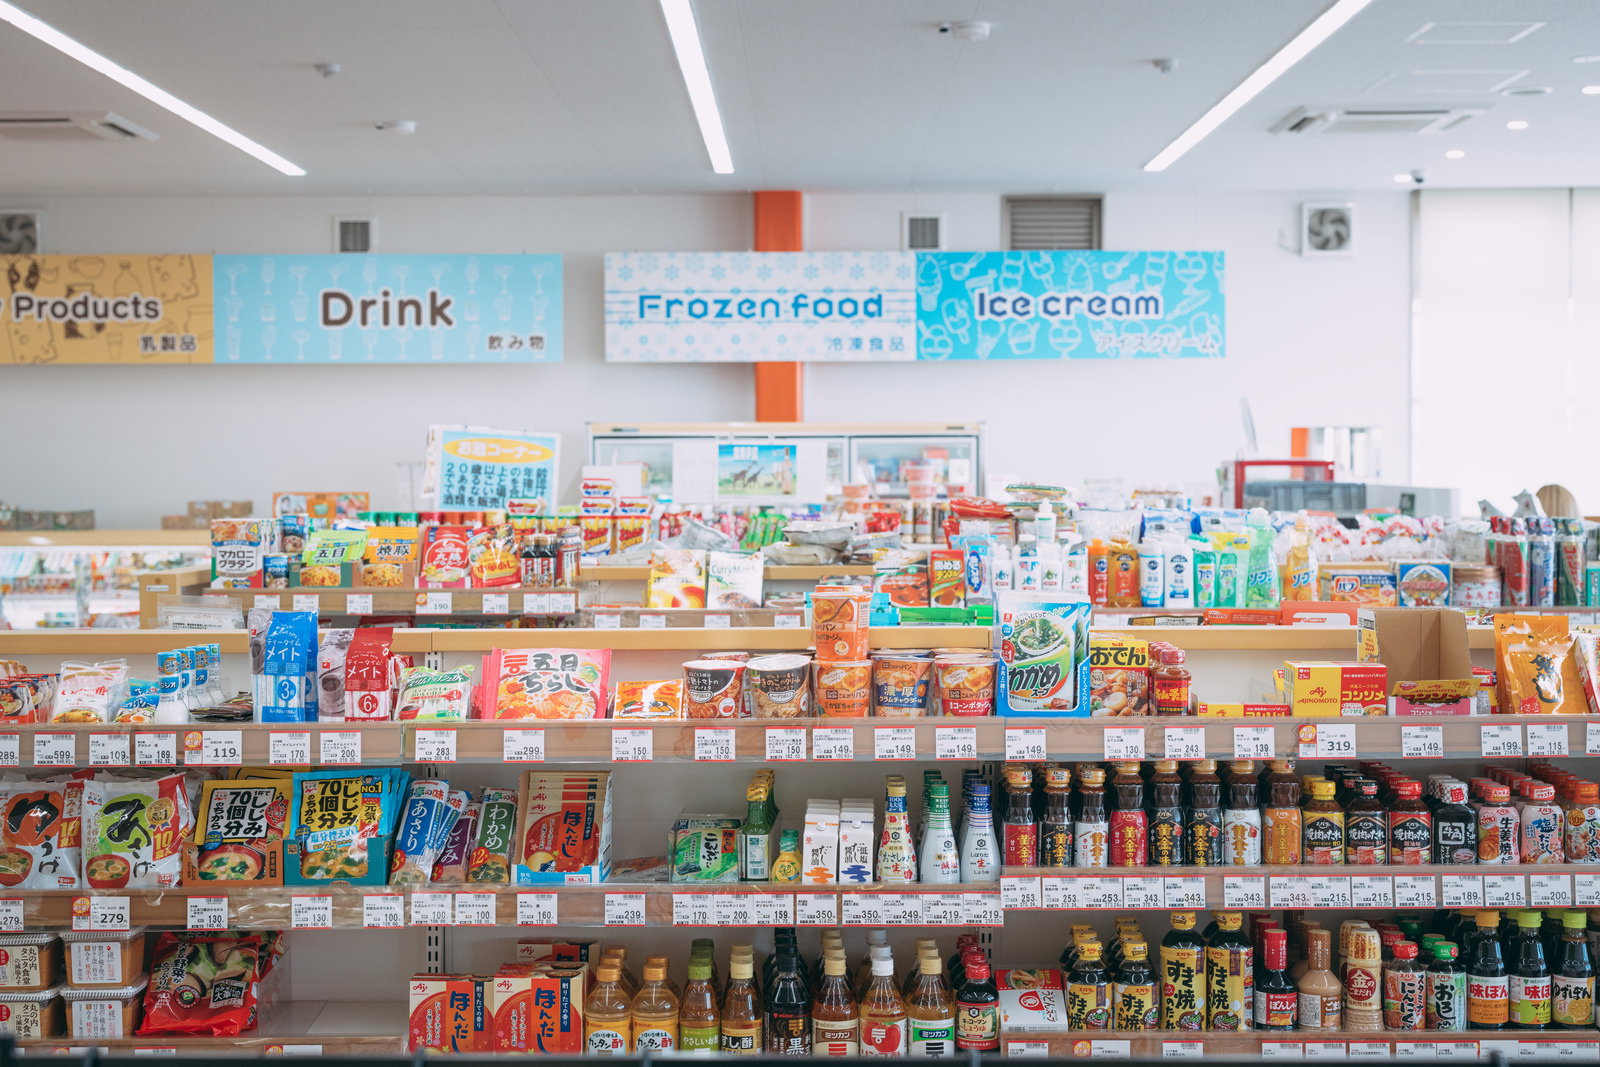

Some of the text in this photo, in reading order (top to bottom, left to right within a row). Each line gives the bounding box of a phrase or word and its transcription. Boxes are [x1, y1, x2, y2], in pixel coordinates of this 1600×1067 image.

[14, 295, 161, 319] Products
[321, 290, 455, 328] Drink
[639, 293, 883, 319] Frozen food
[978, 291, 1160, 318] Ice cream
[140, 336, 196, 353] 乳製品
[488, 335, 545, 352] 飲み物
[827, 335, 905, 352] 冷凍食品
[1097, 333, 1218, 352] アイスクリーム
[218, 550, 254, 559] マカロニ
[218, 559, 254, 568] グラタン
[316, 547, 345, 559] 五目
[267, 646, 301, 661] メイト
[529, 653, 579, 672] 五目
[1090, 647, 1146, 666] おでん
[347, 666, 381, 679] メイト
[519, 672, 590, 694] ちらし
[1009, 664, 1062, 692] わかめ
[1031, 687, 1050, 697] スープ
[1342, 690, 1386, 701] コンソメ
[210, 802, 225, 830] のちから
[223, 791, 252, 836] 70個分
[245, 796, 269, 836] しじみ
[304, 795, 316, 824] のちから
[317, 780, 341, 829] 70個分
[339, 785, 360, 825] しじみ
[407, 801, 428, 851] あさり
[485, 804, 508, 849] わかめ
[561, 810, 583, 858] ほんだし
[1585, 818, 1599, 862] てりやき
[891, 862, 901, 872] 生
[976, 858, 986, 868] 生
[21, 947, 32, 986] タニタ食堂
[28, 947, 38, 971] 丸の内
[1167, 960, 1196, 1010] すき焼
[1350, 969, 1375, 988] 金の
[1401, 981, 1416, 1024] にんにく
[1434, 983, 1456, 1020] おろし
[1469, 984, 1508, 999] 味ぽん
[1552, 984, 1591, 1001] ゆずぽん
[29, 1003, 39, 1027] 丸の内
[475, 985, 483, 1030] 削りたての香り
[561, 981, 569, 1027] 削りたての香り
[1041, 991, 1056, 1022] うどんスープ
[450, 990, 471, 1054] ほんだし
[535, 987, 556, 1054] ほんだし
[963, 1025, 987, 1033] しょうゆ
[588, 1037, 624, 1049] カンタン酢
[636, 1037, 673, 1048] カンタン酢
[721, 1036, 754, 1049] すし酢
[824, 1030, 851, 1039] ミツカン
[921, 1030, 948, 1038] ミツカン
